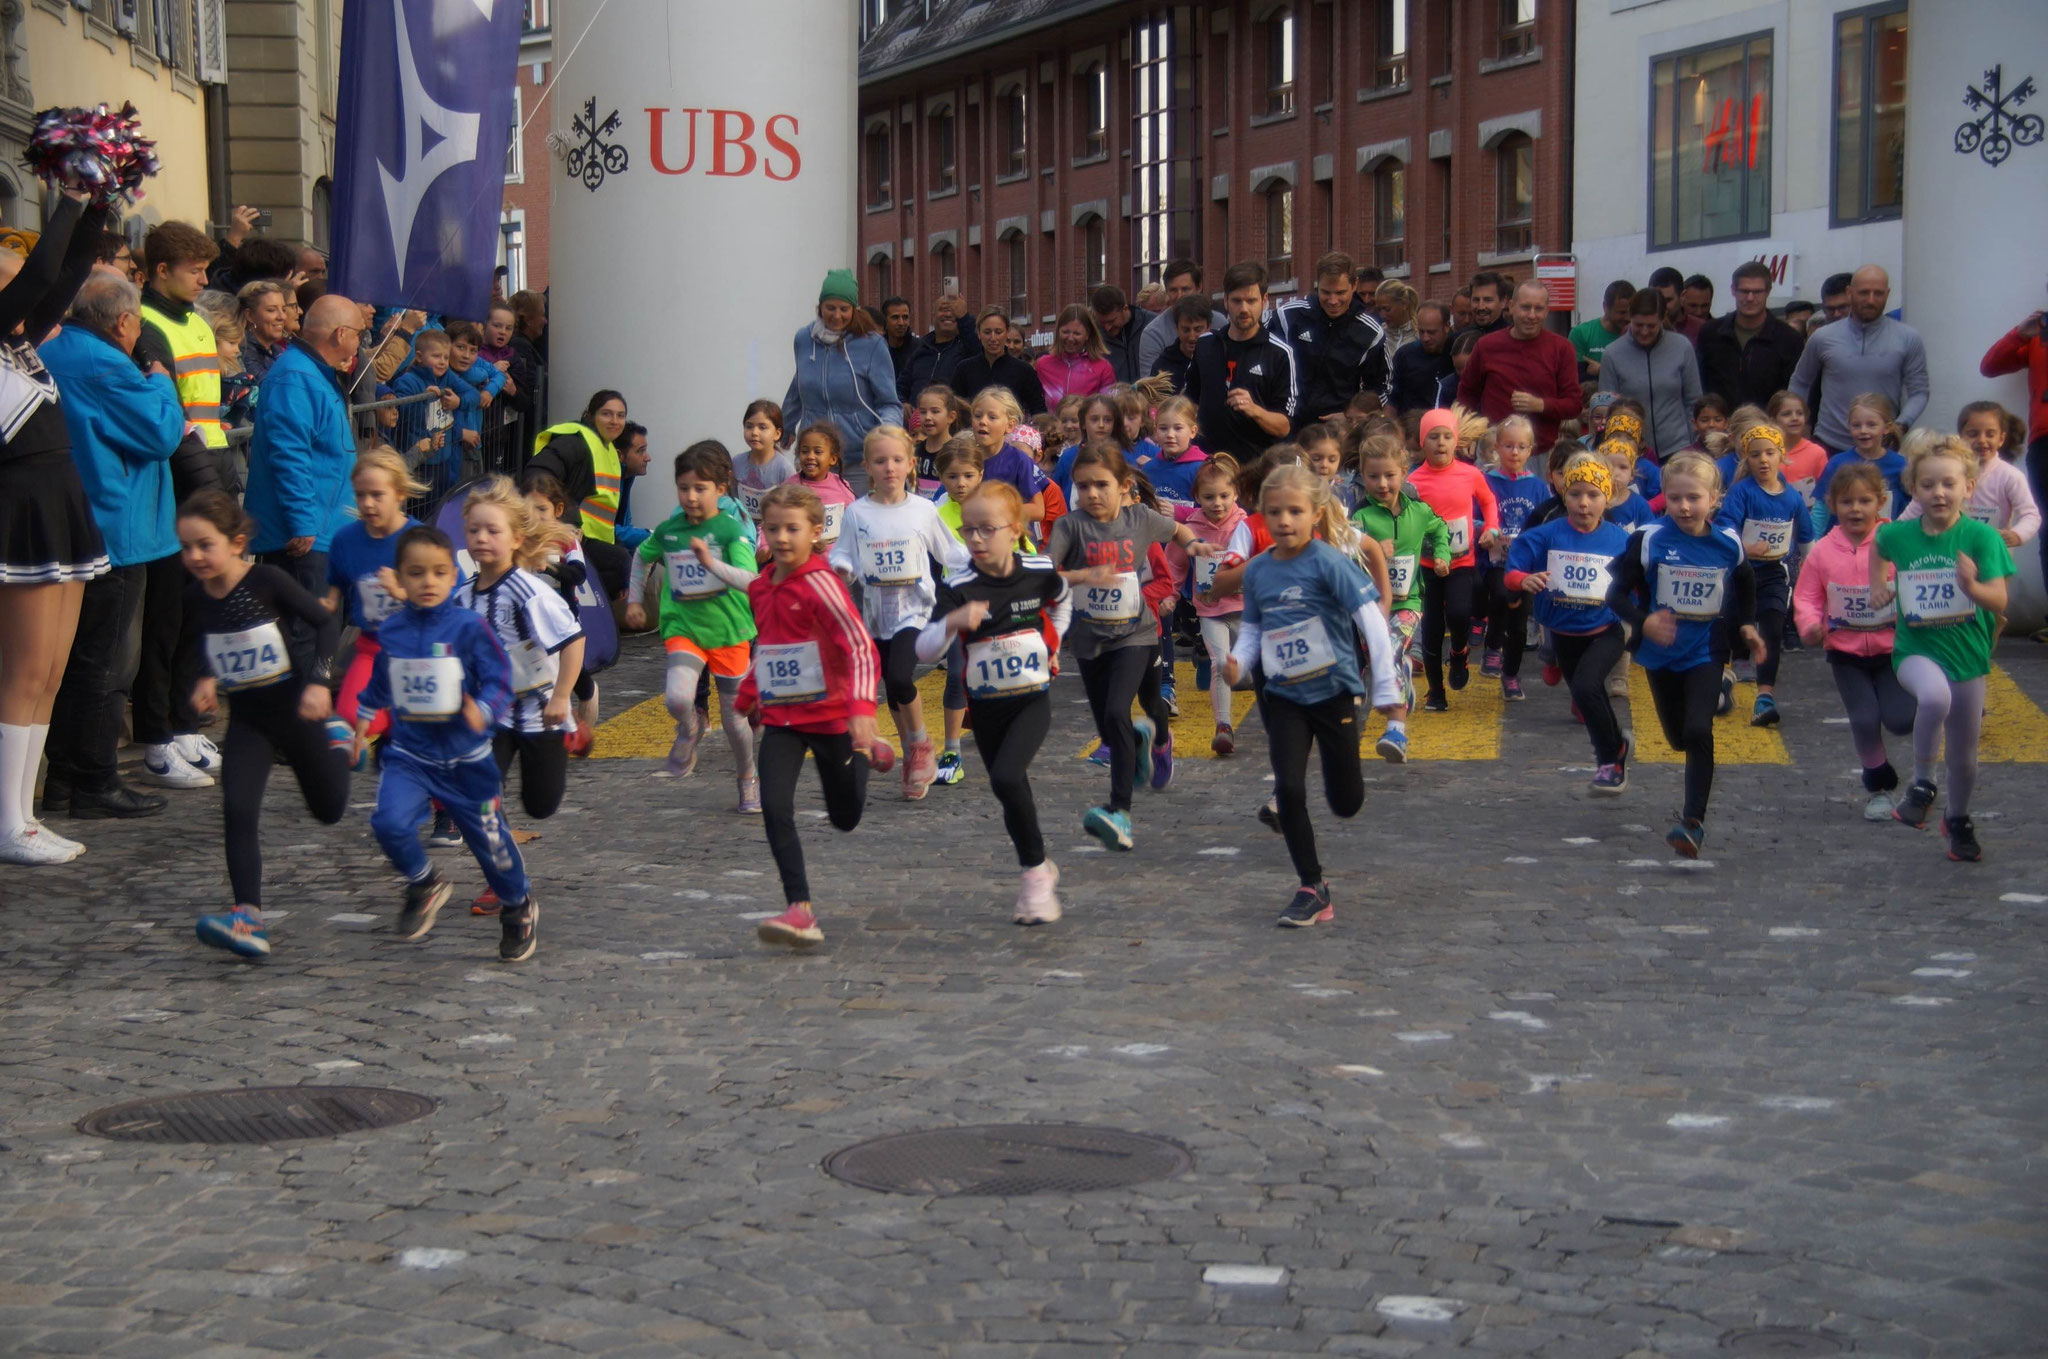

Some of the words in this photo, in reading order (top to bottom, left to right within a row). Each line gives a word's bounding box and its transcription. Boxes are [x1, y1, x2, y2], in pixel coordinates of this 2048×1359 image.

[643, 108, 801, 181] UBS
[1759, 531, 1785, 545] 566
[874, 550, 905, 566] 313
[1086, 539, 1134, 565] GIRLS
[1565, 554, 1604, 564] INTERSPORT
[676, 564, 707, 579] 708
[1563, 565, 1598, 582] 809
[1676, 570, 1719, 579] INTERSPORT
[1567, 581, 1591, 589] LENIA
[1671, 581, 1716, 598] 1187
[1915, 583, 1955, 601] 278
[1087, 587, 1122, 603] 479
[1676, 597, 1703, 606] KIARA
[1089, 603, 1119, 611] NOELLE
[1843, 597, 1871, 611] 25
[1919, 602, 1950, 611] ILARIA
[1847, 611, 1875, 619] LEONIE
[1276, 638, 1310, 660] 478
[216, 643, 278, 674] 1274
[976, 652, 1041, 681] 1194
[767, 660, 800, 678] 188
[402, 676, 437, 694] 246
